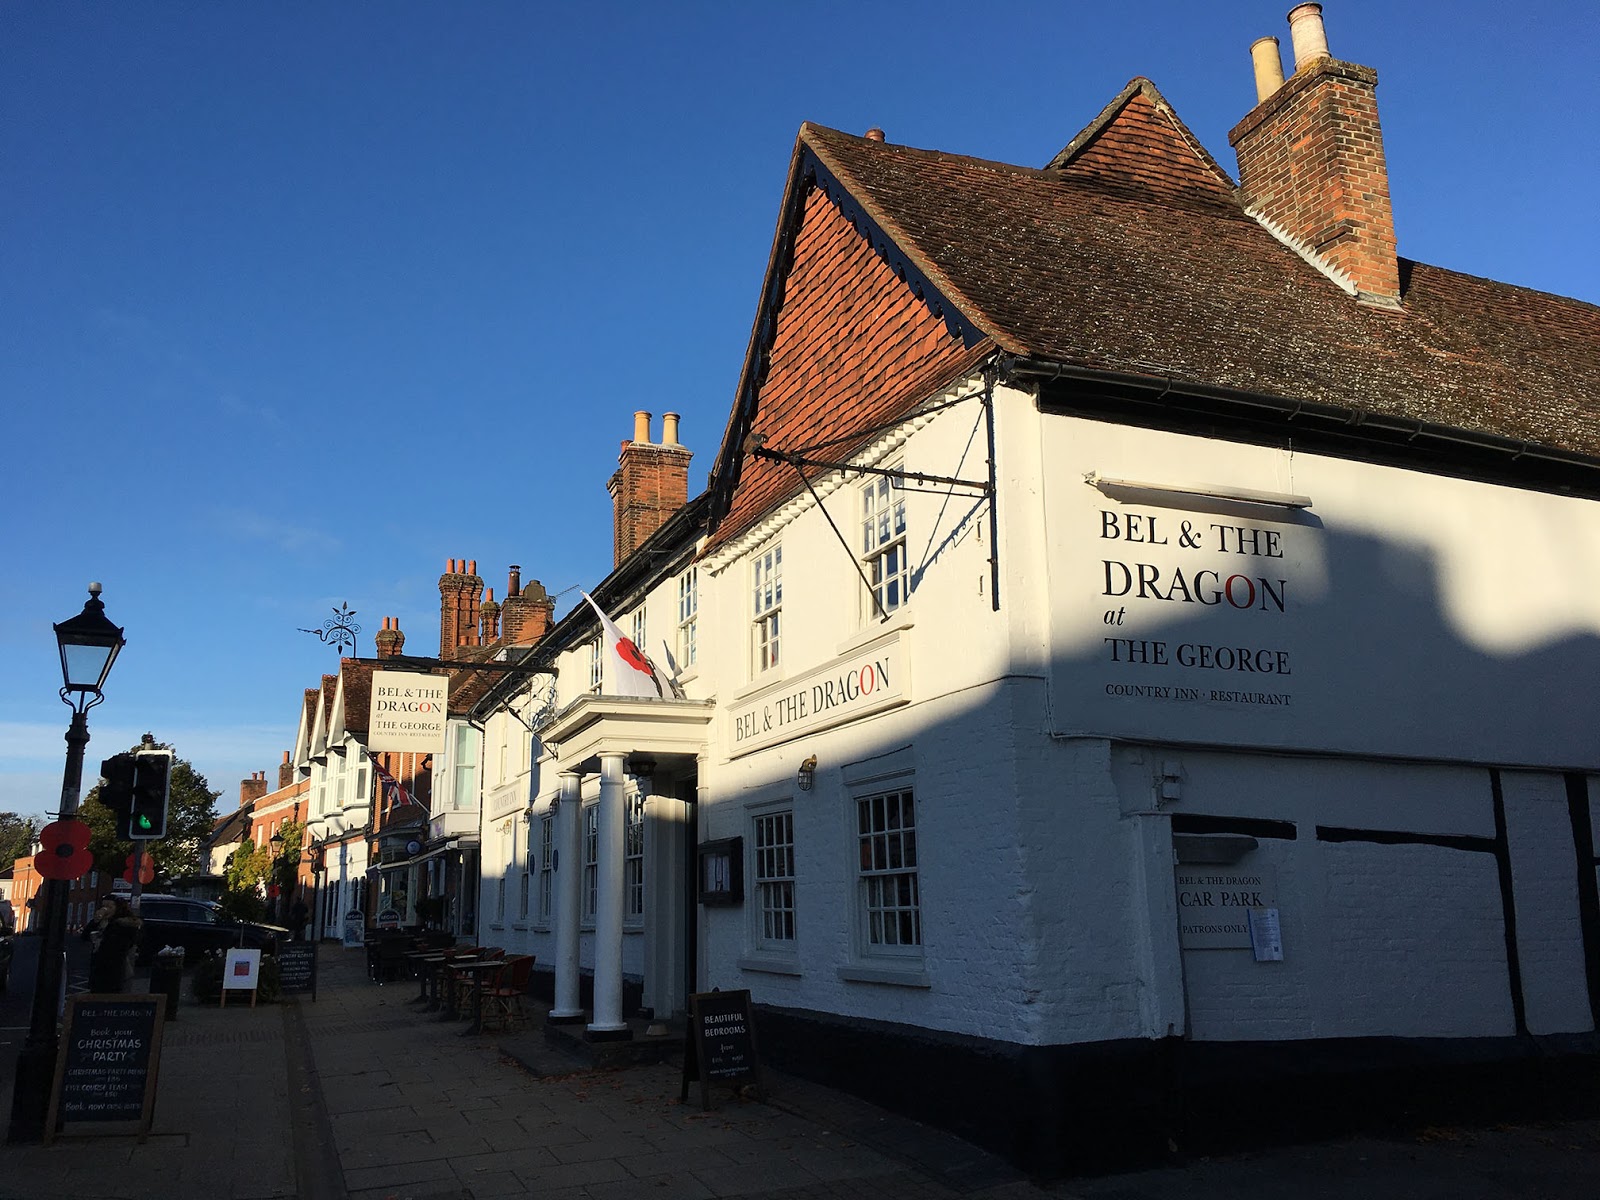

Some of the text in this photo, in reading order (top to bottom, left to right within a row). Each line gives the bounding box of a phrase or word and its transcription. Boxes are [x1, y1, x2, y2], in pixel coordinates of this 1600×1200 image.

[1099, 510, 1284, 558] BEL & THE
[1101, 560, 1287, 612] DRAGON
[1103, 606, 1125, 625] at
[1104, 637, 1291, 675] THE GEORGE
[378, 687, 443, 699] BEL & THE
[1105, 684, 1291, 706] COUNTRY INN RESTAURANT
[736, 657, 889, 742] BEL & THE DRAGON
[377, 700, 442, 713] DRAGON
[376, 720, 441, 731] THE GEORGE
[1179, 876, 1261, 885] BEL & THE DRAGON
[1180, 891, 1264, 907] CAR PARK
[1183, 924, 1248, 934] PATRONS ONLY
[119, 1009, 153, 1017] DRAGN
[704, 1012, 744, 1024] BEAUTIFUL
[90, 1027, 133, 1039] Book your
[704, 1025, 746, 1037] BEDROOMS
[77, 1038, 142, 1049] CHRISTMAS
[92, 1051, 128, 1062] PARTY
[65, 1101, 86, 1111] Book
[88, 1103, 106, 1111] now
